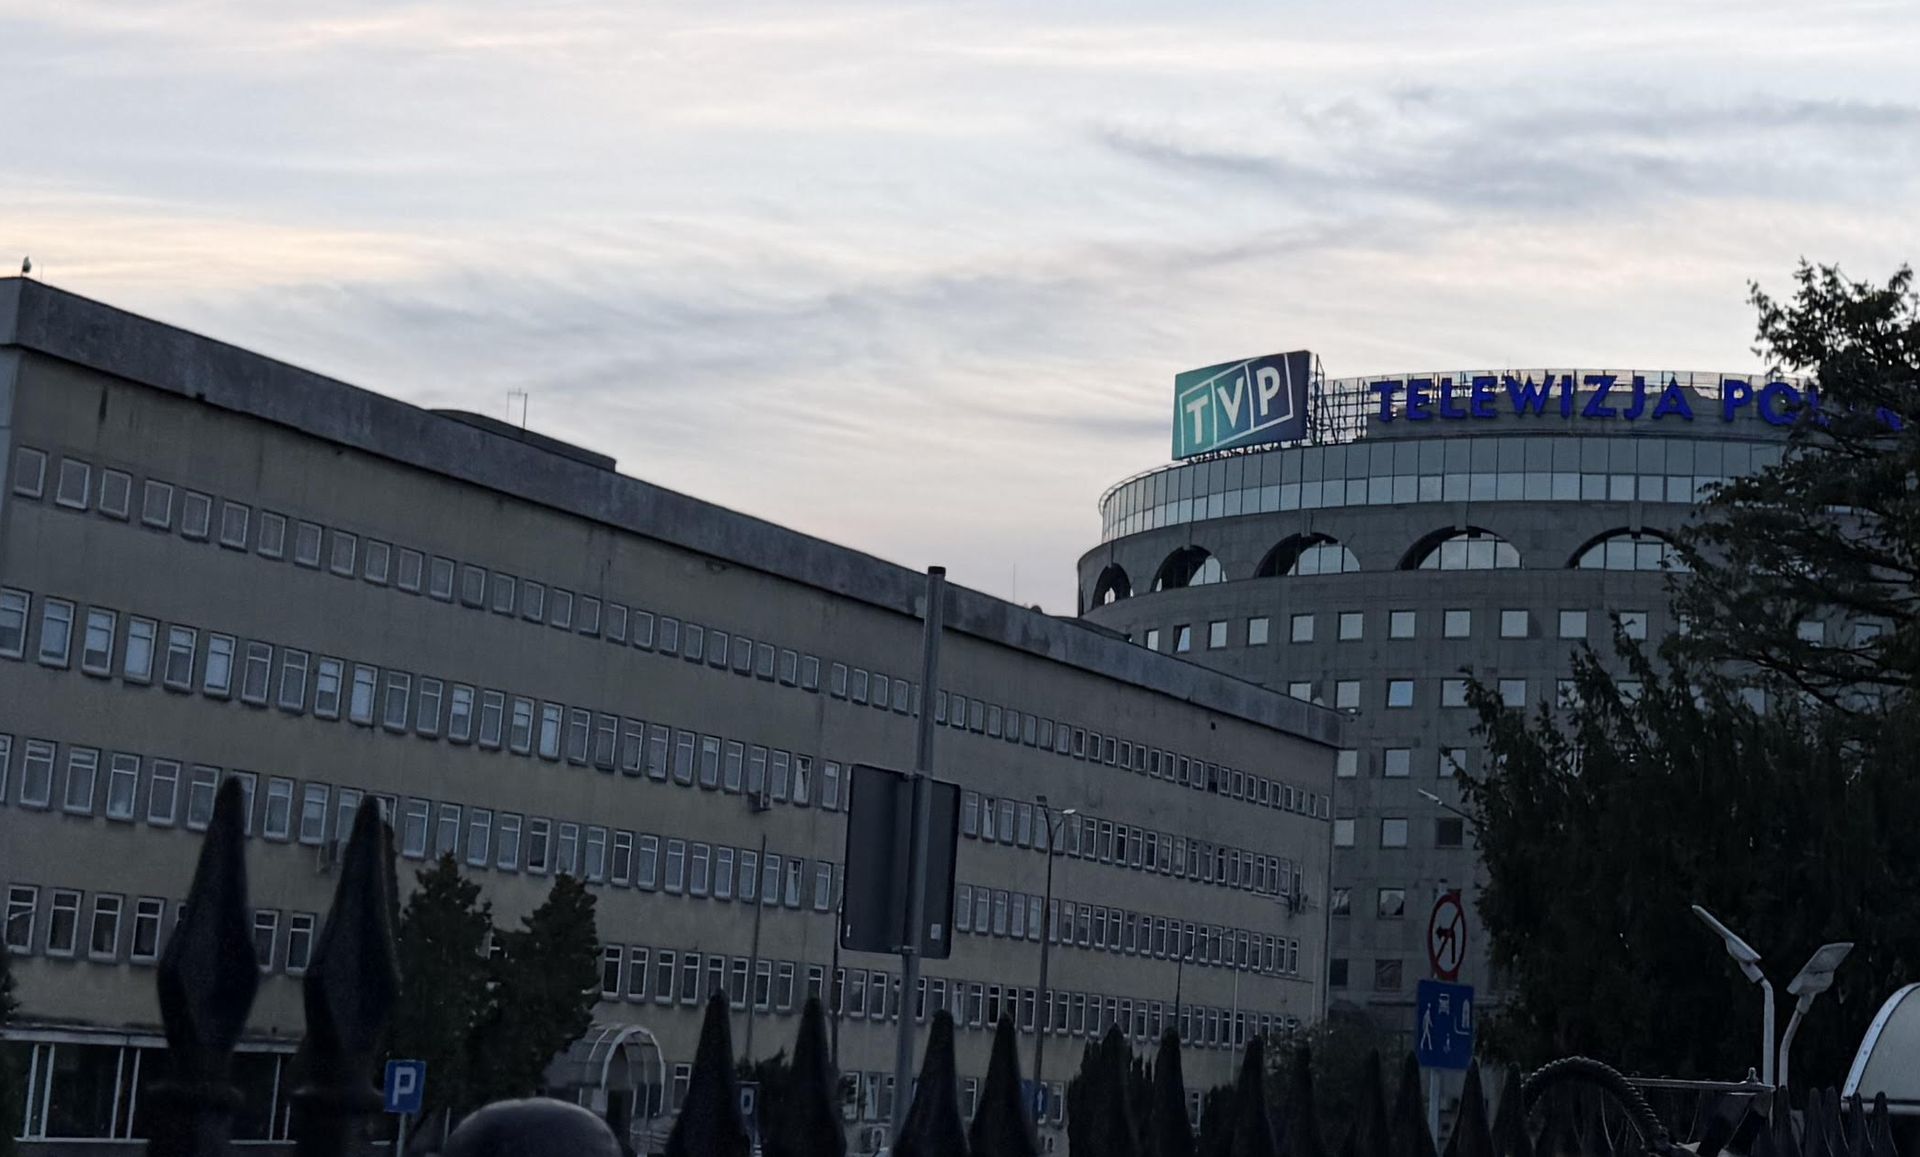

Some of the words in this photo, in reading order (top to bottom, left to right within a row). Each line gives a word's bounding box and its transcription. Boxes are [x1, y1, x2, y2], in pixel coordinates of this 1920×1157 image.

[1186, 366, 1281, 445] TVP
[1370, 374, 1693, 423] TELEWIZJA
[392, 1066, 416, 1106] P
